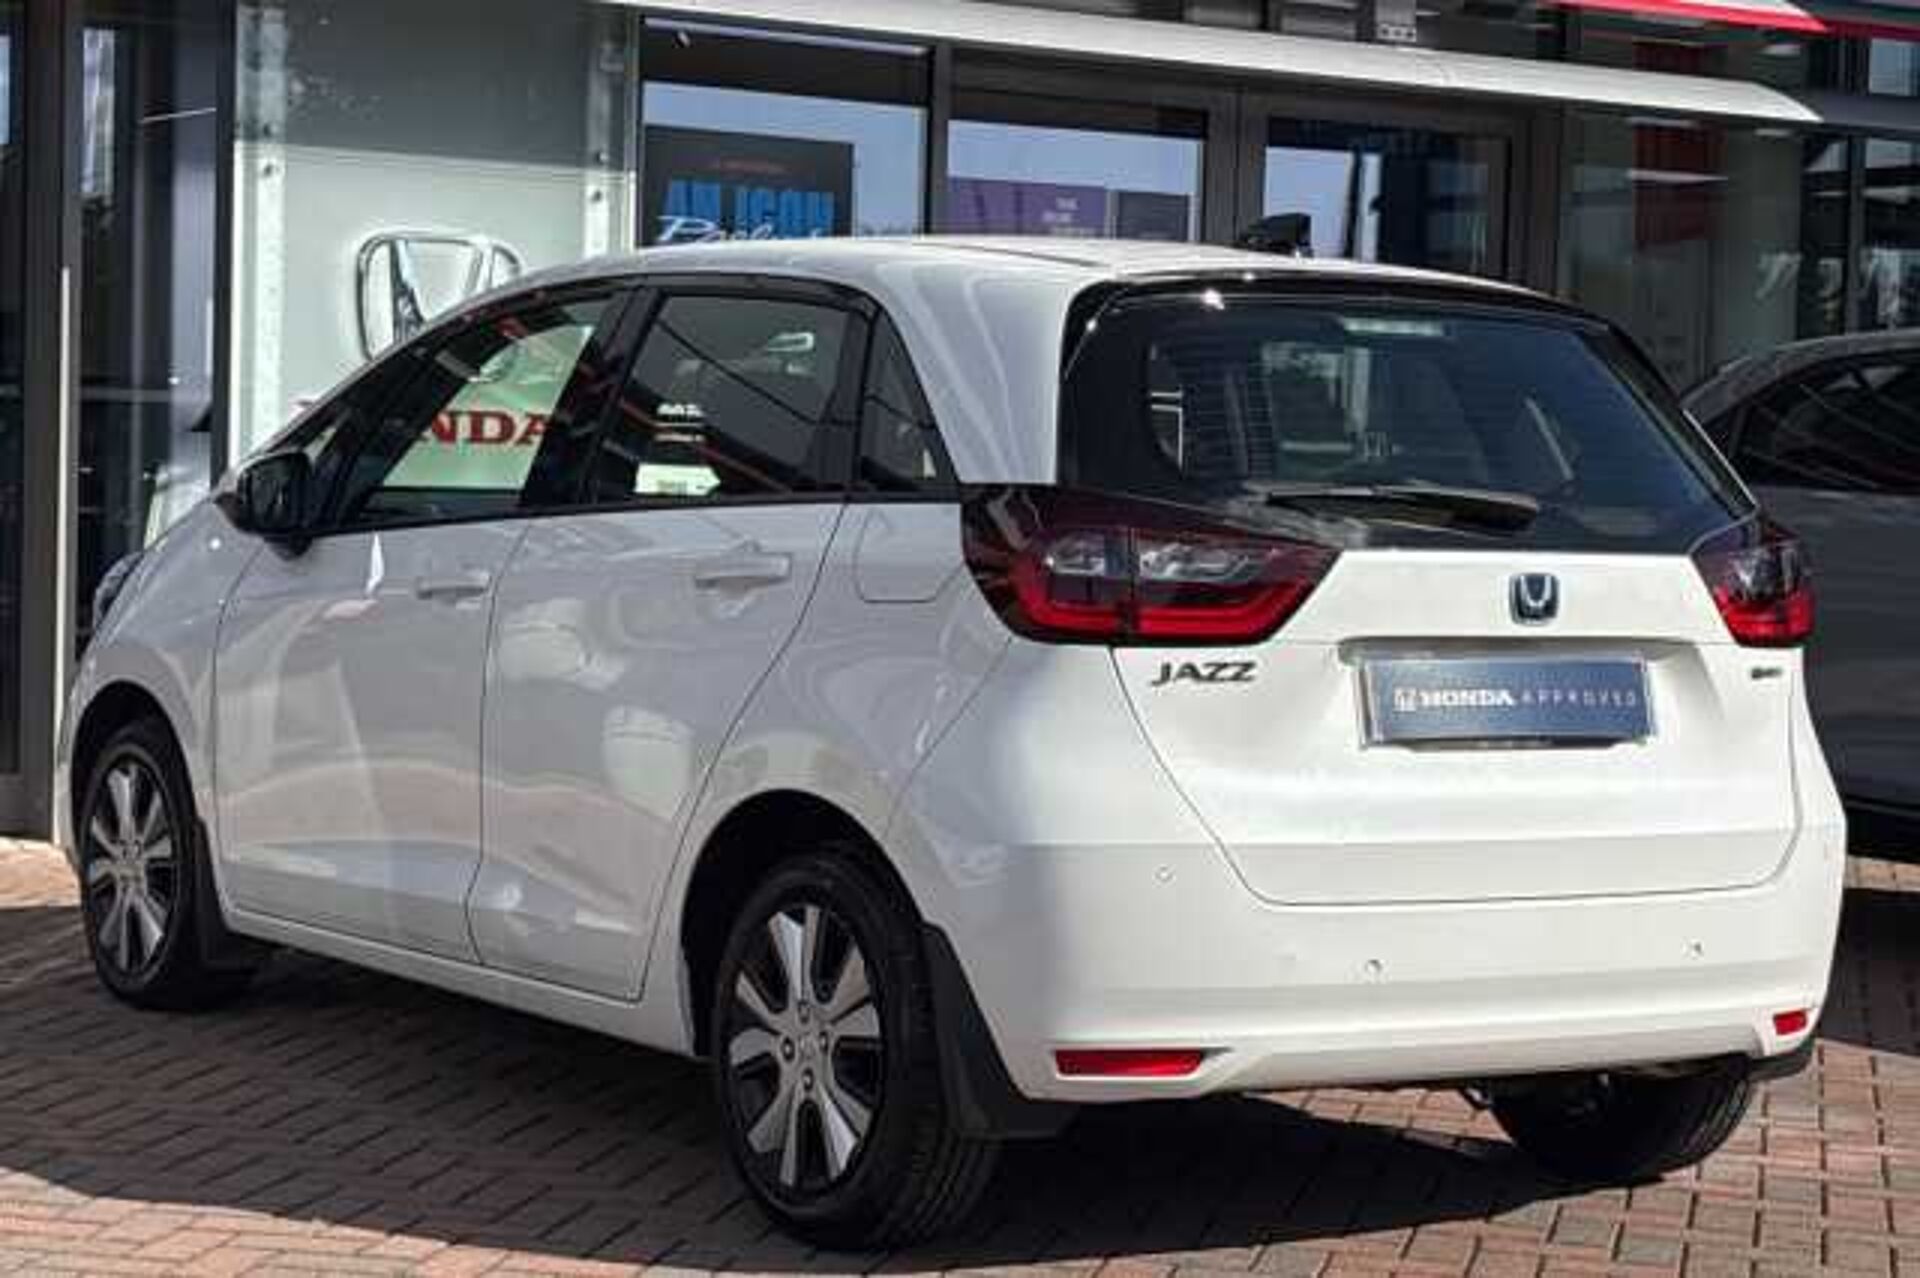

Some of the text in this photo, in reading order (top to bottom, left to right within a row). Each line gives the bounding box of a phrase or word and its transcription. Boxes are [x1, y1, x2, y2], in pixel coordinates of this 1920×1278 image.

[422, 410, 547, 445] NDA
[1151, 661, 1257, 685] JAZZ
[1421, 689, 1515, 706] HONDA
